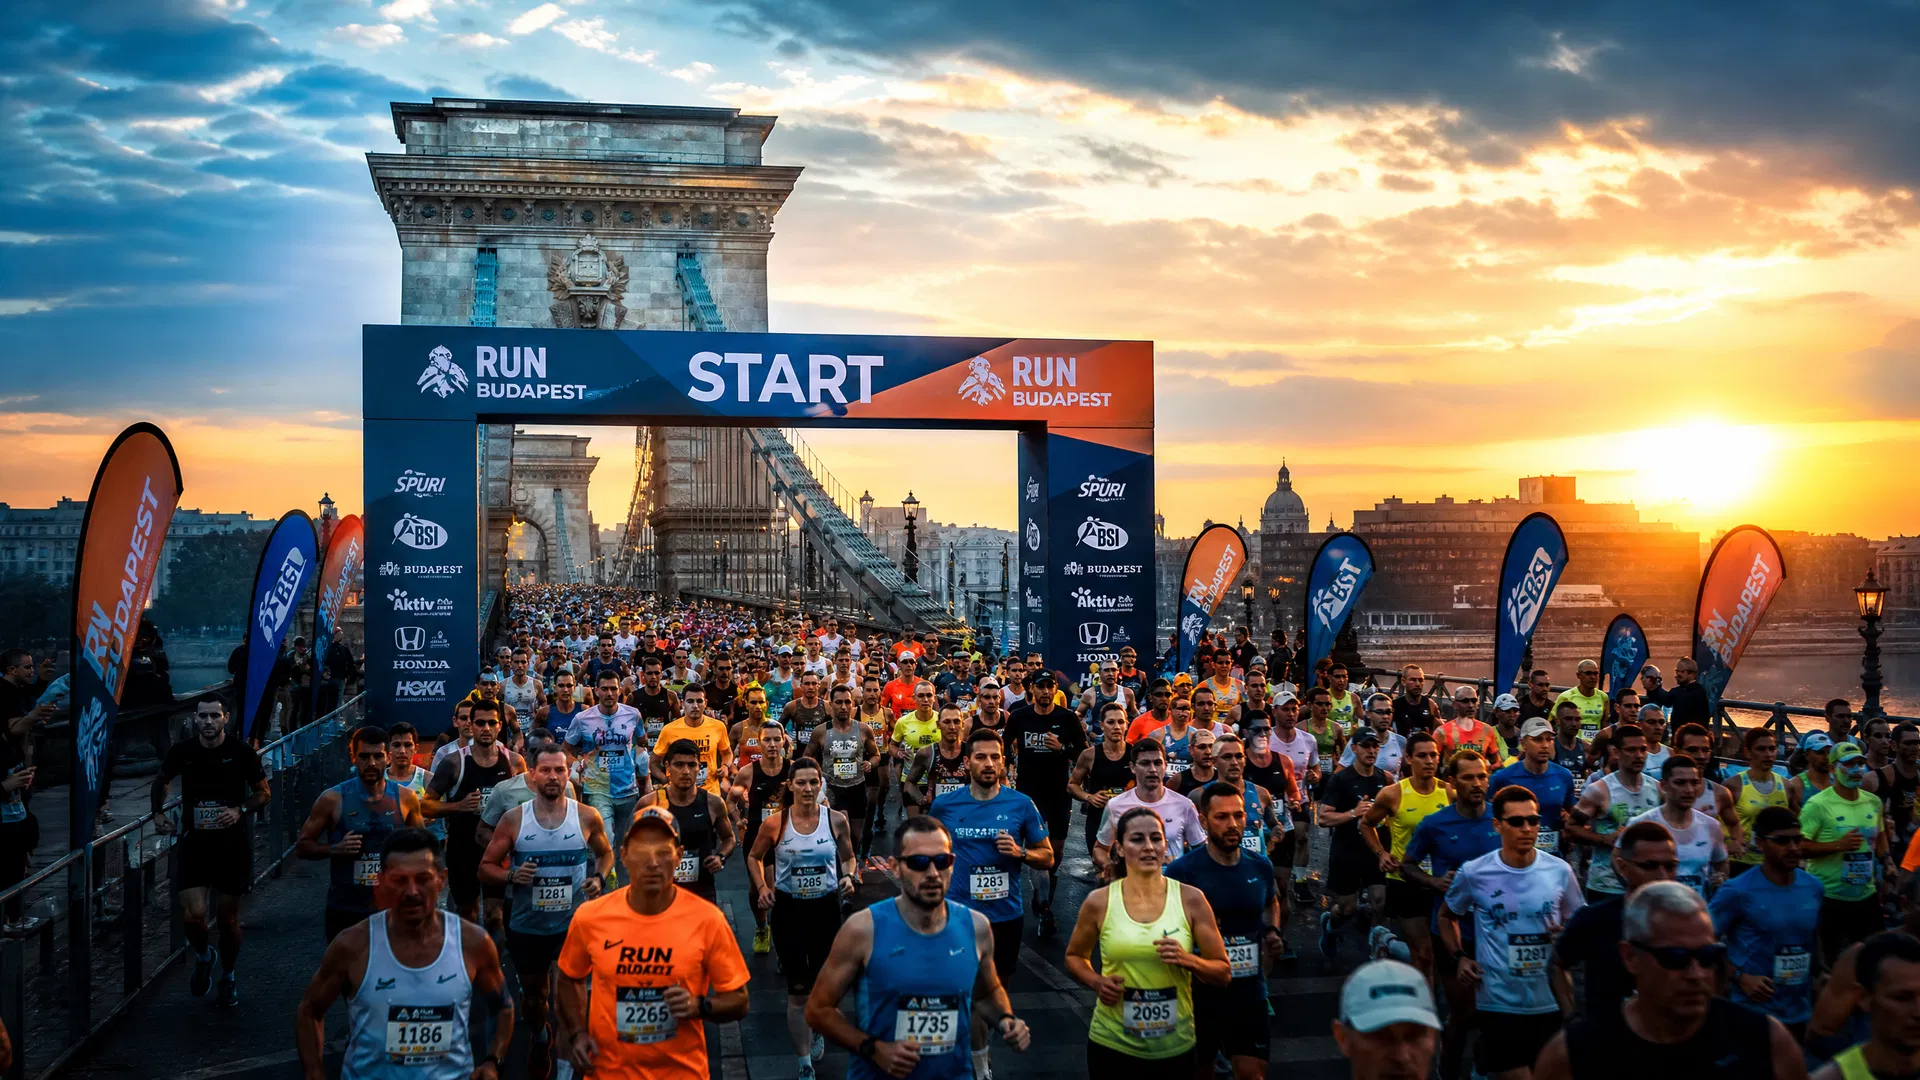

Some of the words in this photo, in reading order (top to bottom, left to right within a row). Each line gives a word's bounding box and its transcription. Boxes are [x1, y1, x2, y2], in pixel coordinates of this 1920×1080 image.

[476, 346, 547, 379] RUN
[688, 351, 884, 404] START
[1012, 356, 1076, 387] RUN
[476, 383, 586, 399] BUDAPEST
[1012, 391, 1112, 407] BUDAPEST
[394, 476, 446, 493] SPURI
[1078, 482, 1126, 497] SPURI
[415, 525, 438, 546] BSI
[1098, 528, 1119, 547] BSI
[404, 565, 463, 574] BUDAPEST
[1087, 565, 1143, 574] BUDAPEST
[105, 476, 159, 697] BUDAPEST
[1202, 544, 1237, 614] BUDAPEST
[393, 597, 435, 611] Aktiv
[1077, 595, 1116, 607] Aktiv
[1720, 553, 1770, 665] BUDAPEST
[393, 660, 450, 669] HONDA
[1077, 654, 1121, 662] HOND
[396, 680, 446, 696] HOKA
[977, 876, 1003, 888] 1283
[539, 888, 566, 899] 1281
[619, 947, 673, 963] RUN
[625, 1006, 669, 1023] 2265
[1132, 1003, 1170, 1020] 2095
[907, 1015, 949, 1034] 1735
[398, 1026, 442, 1044] 1186
